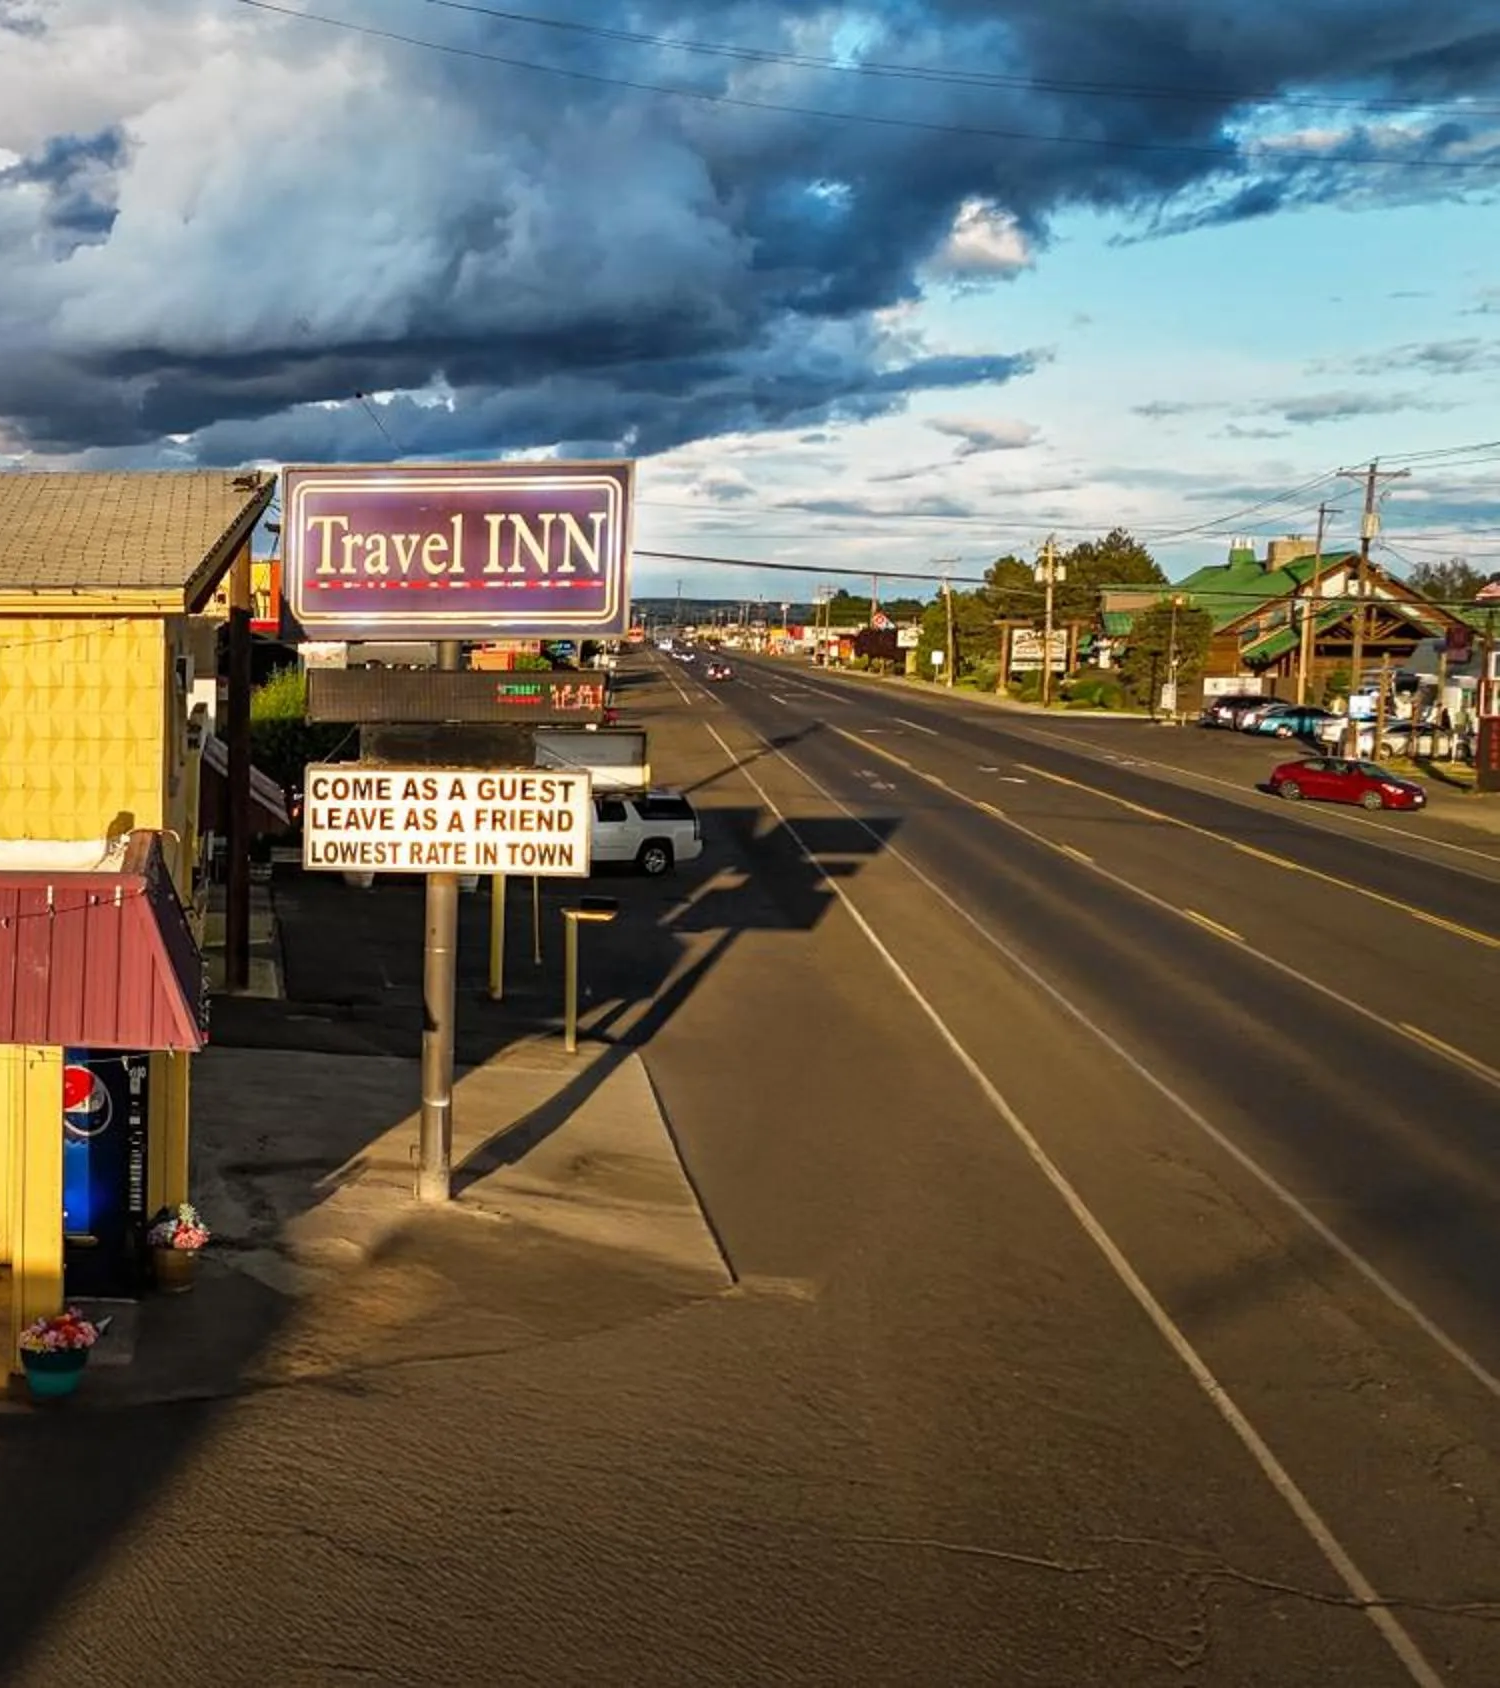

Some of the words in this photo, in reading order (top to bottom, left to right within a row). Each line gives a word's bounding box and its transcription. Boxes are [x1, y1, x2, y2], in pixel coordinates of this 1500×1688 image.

[306, 513, 466, 575] Travel
[482, 512, 608, 575] INN
[312, 777, 393, 801] COME
[402, 777, 438, 801] AS
[448, 778, 467, 801] A
[476, 778, 575, 803] GUEST
[311, 807, 394, 831] LEAVE
[403, 807, 438, 831] AS
[446, 809, 465, 832] A
[474, 809, 575, 833] FRIEND
[311, 840, 401, 865] LOWEST
[409, 841, 467, 865] RATE
[475, 842, 498, 866] IN
[507, 842, 574, 867] TOWN
